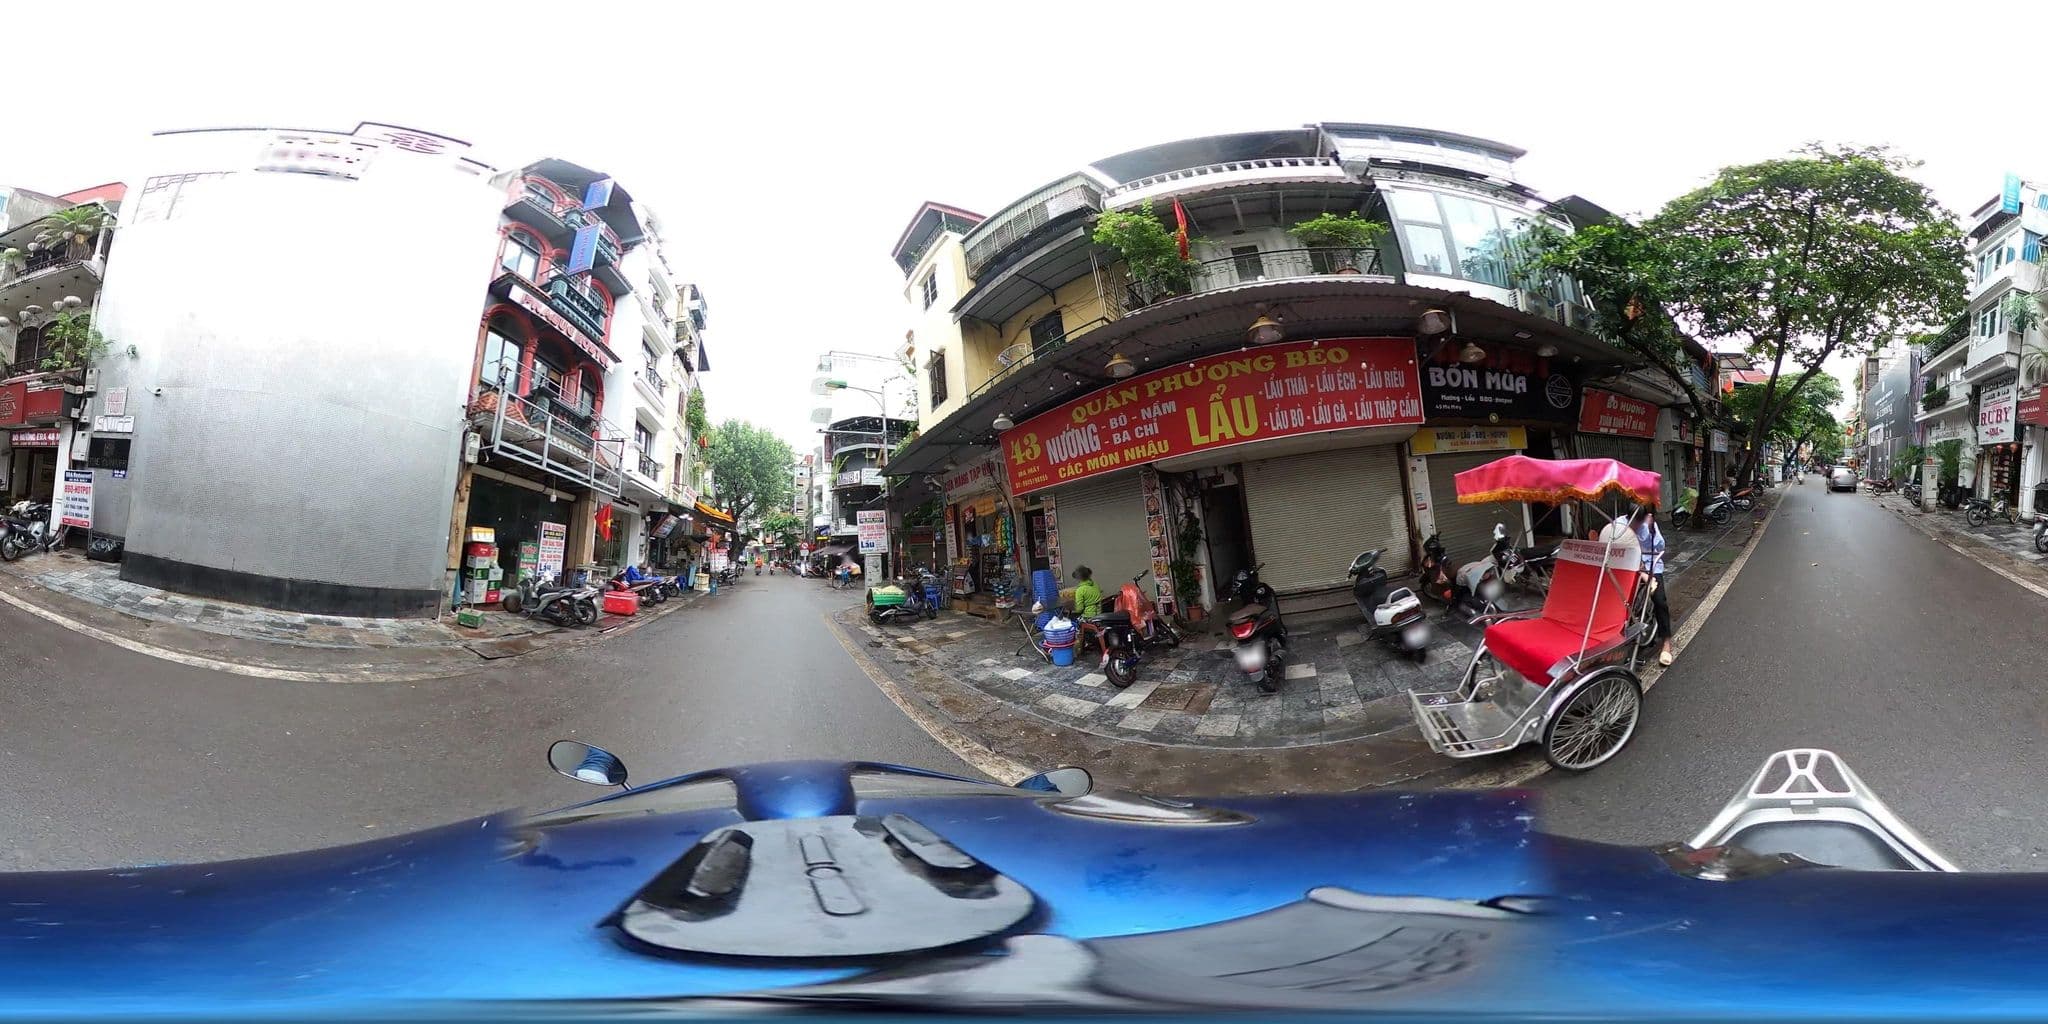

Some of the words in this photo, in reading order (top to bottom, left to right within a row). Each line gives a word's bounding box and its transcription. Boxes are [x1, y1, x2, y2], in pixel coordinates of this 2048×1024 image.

[1071, 387, 1138, 423] QUÁN
[1145, 354, 1276, 397] PHƯƠNG
[1264, 373, 1284, 400] LẨU
[1285, 371, 1309, 397] THÁI
[1316, 367, 1336, 393] LẨU
[1336, 366, 1357, 391] ẾCH
[1364, 364, 1383, 389] LẨU
[1384, 367, 1405, 388] RIÊU
[1429, 362, 1478, 388] BỐN
[1485, 369, 1528, 394] MÙA
[1109, 412, 1128, 429] BÒ
[1186, 383, 1259, 446] LẨU
[1269, 403, 1289, 431] LẨU
[1290, 403, 1305, 427] BÒ
[1312, 398, 1331, 424] LẨU
[1333, 400, 1348, 422] GÀ
[1355, 394, 1373, 420] LẨU
[1374, 396, 1397, 422] THẬP
[1399, 392, 1420, 418] CẨM
[1980, 406, 2012, 426] RUBY
[1011, 433, 1041, 465] 43
[1046, 424, 1101, 465] NƯỚNG
[1112, 430, 1131, 445] BA
[1058, 461, 1083, 479] CÁC
[1087, 452, 1120, 471] MÓN
[1124, 439, 1170, 462] NHẬU
